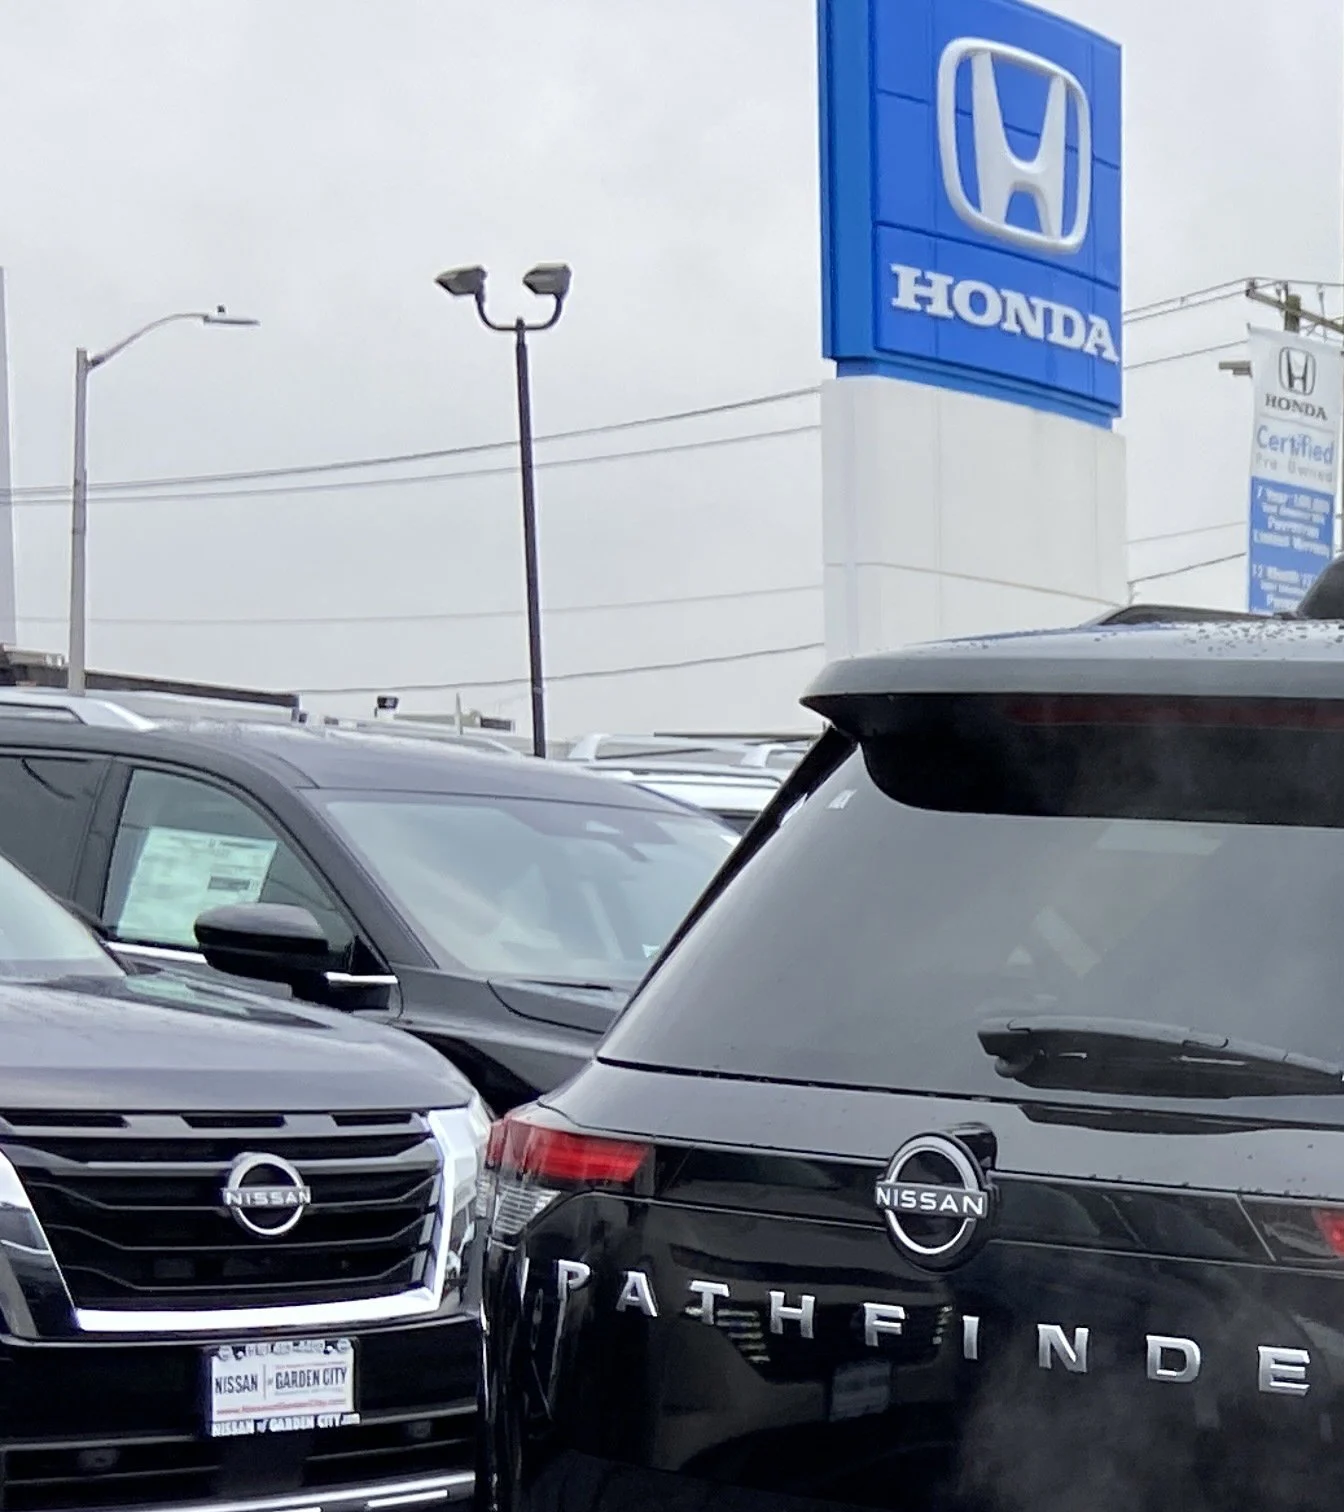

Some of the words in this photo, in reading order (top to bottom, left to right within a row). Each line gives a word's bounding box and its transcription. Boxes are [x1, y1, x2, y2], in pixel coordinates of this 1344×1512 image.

[891, 263, 1120, 363] HONDA
[1265, 393, 1328, 420] HONDA
[1257, 424, 1334, 464] Certified
[226, 1190, 311, 1206] NISSAN
[876, 1186, 983, 1215] NISSAN
[215, 1374, 258, 1395] NISSAN
[275, 1369, 320, 1390] GARDEN
[323, 1366, 347, 1386] CITY
